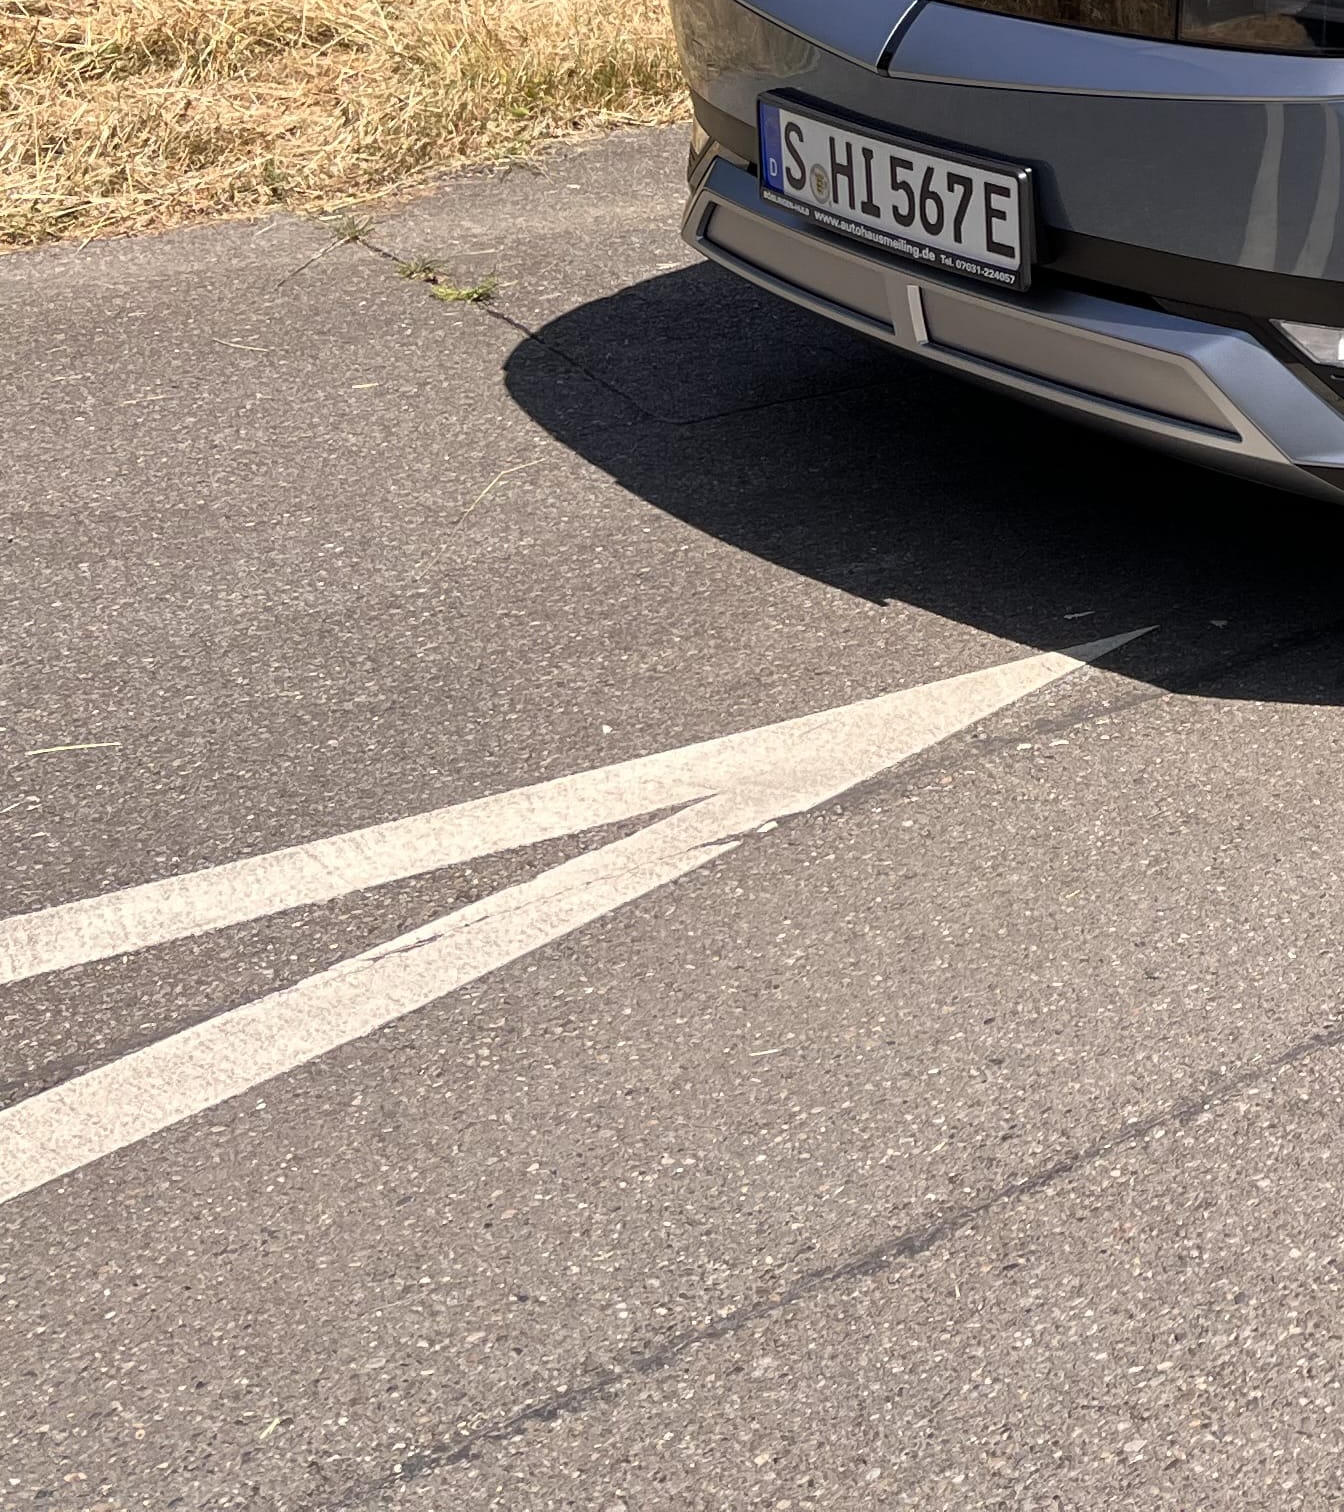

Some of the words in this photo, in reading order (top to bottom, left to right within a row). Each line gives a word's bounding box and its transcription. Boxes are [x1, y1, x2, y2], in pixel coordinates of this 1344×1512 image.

[769, 157, 778, 177] D
[784, 121, 807, 191] S
[889, 155, 1016, 259] 567E
[814, 210, 936, 262] www.autohausmeiling.de
